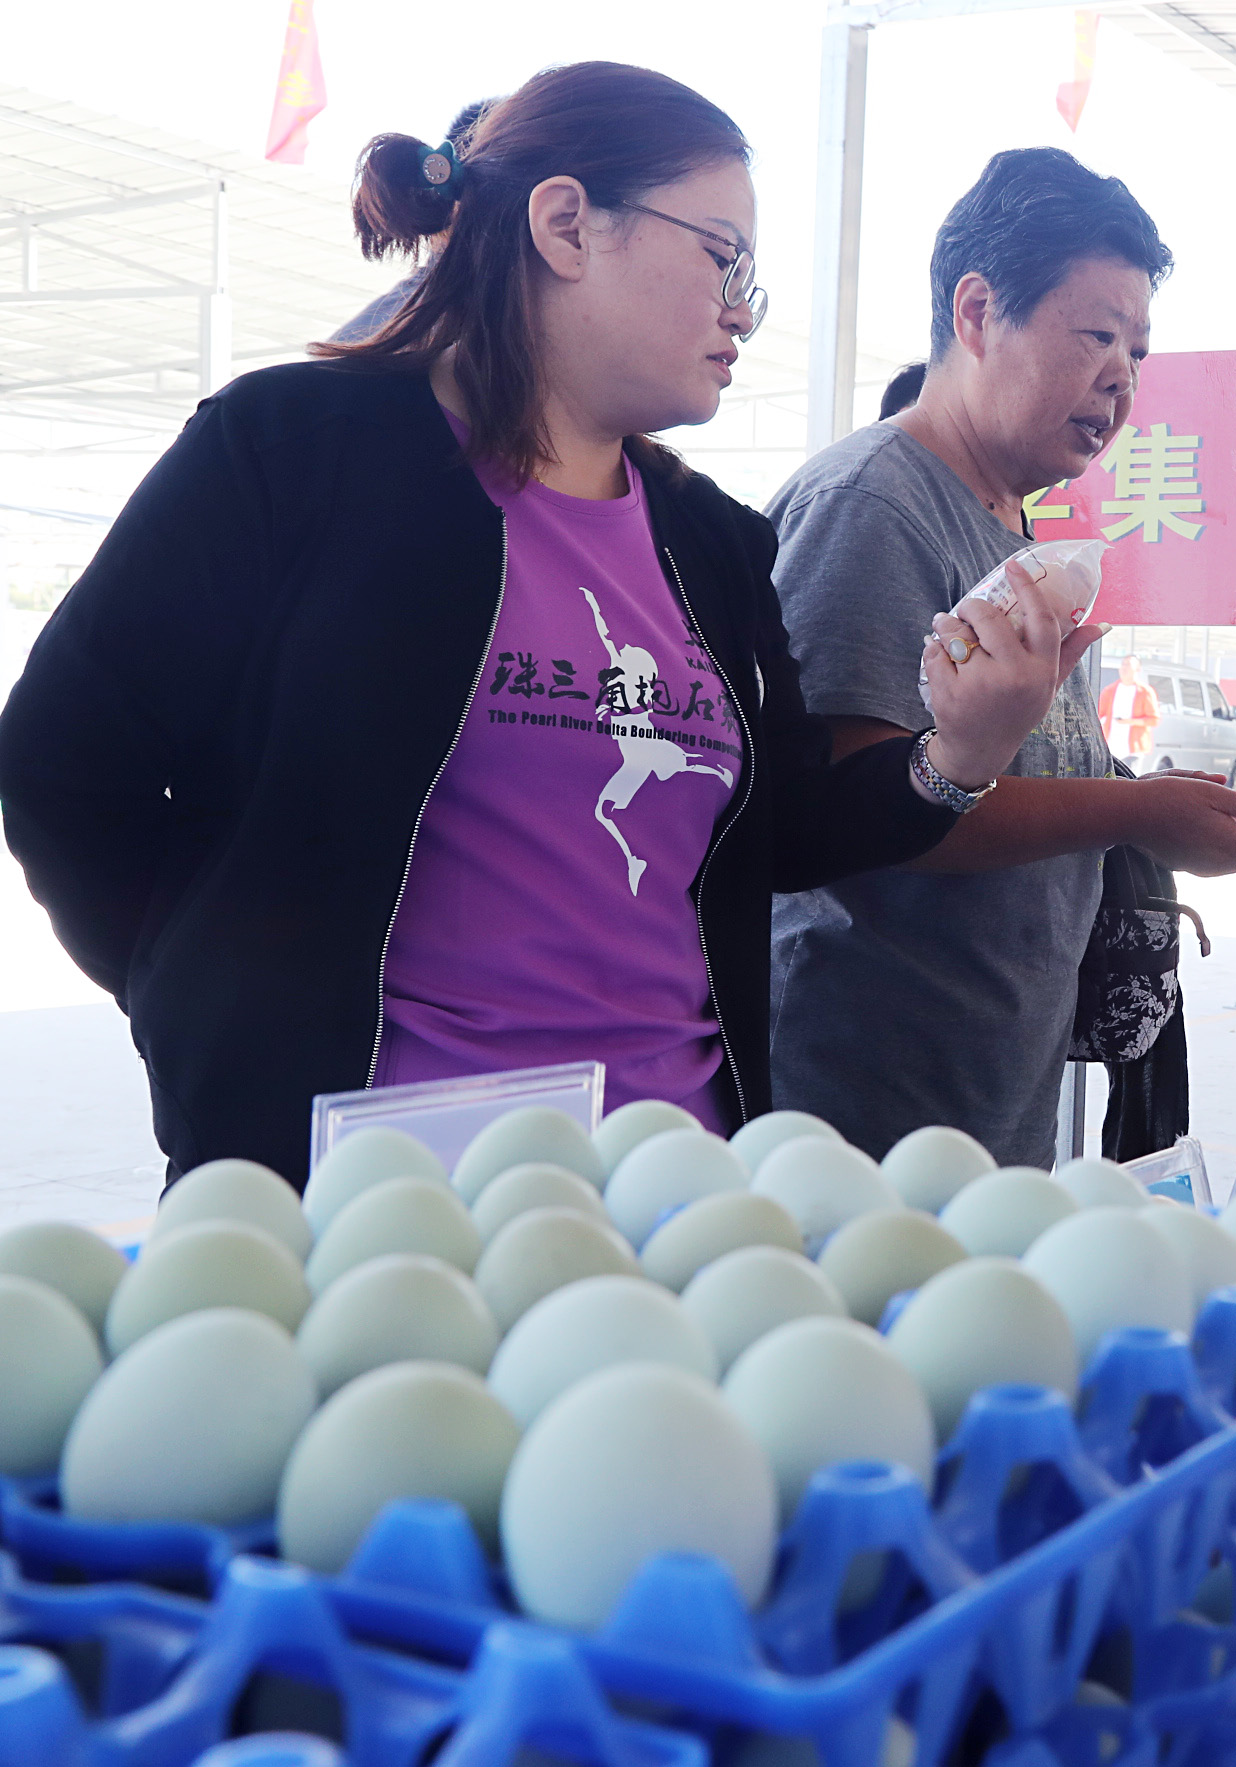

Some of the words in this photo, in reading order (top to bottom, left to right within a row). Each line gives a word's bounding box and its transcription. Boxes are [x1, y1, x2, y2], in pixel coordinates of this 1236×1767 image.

[488, 709, 517, 724] The
[521, 711, 557, 727] Pearl
[560, 714, 593, 732] River
[596, 720, 627, 737] Delta
[630, 724, 697, 747] Bouldering
